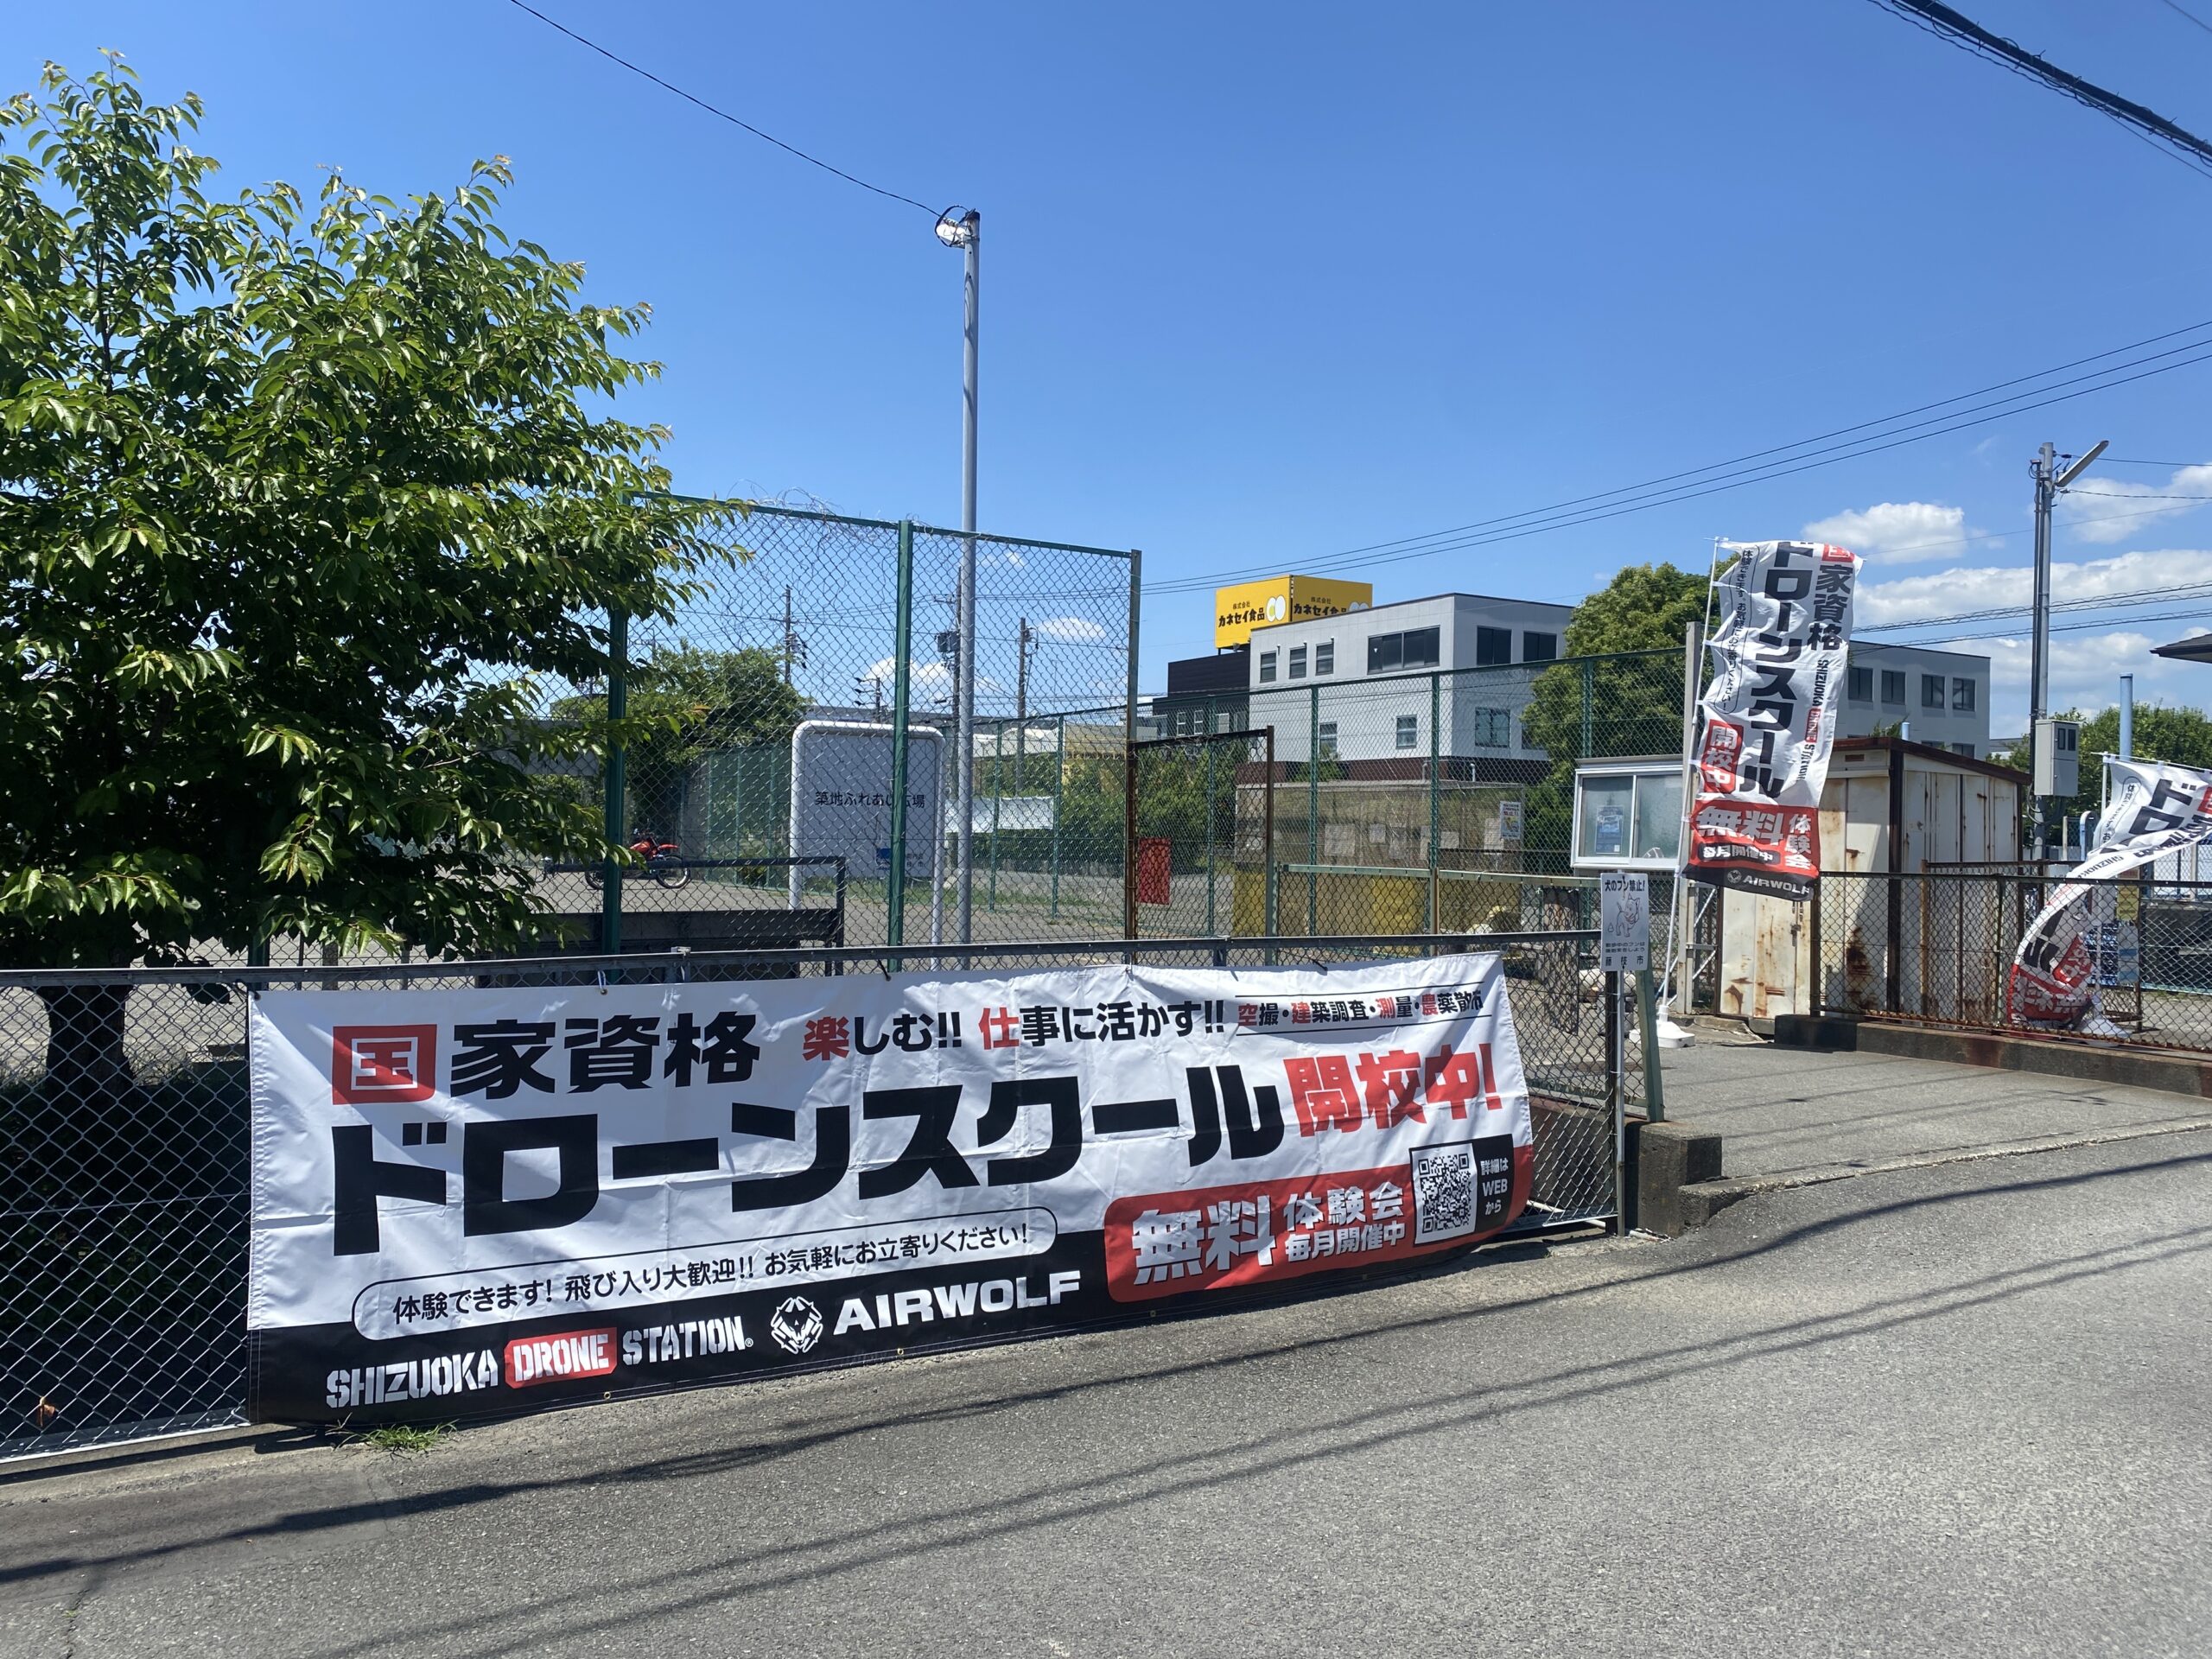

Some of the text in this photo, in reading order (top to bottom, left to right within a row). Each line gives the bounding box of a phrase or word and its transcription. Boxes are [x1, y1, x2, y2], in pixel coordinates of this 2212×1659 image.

[1218, 607, 1265, 627] カネセイ食品
[1812, 659, 1829, 707] SHIZUOKA
[1704, 724, 1738, 791] 開校中
[1696, 805, 1784, 846] 無料
[1785, 814, 1812, 870] 体験会
[1743, 874, 1810, 895] AIRWOLF
[344, 1010, 762, 1101] 国家資格
[1480, 1158, 1509, 1175] 詳細は
[1482, 1179, 1508, 1197] WEB
[1282, 1181, 1404, 1232] 体験会
[1484, 1199, 1502, 1216] から
[1132, 1195, 1276, 1286] 無料
[1285, 1220, 1406, 1262] 毎月開催中
[833, 1270, 1082, 1336] AIRWOLF
[326, 1349, 499, 1408] SHIZUOKA
[513, 1333, 610, 1382] DRONE
